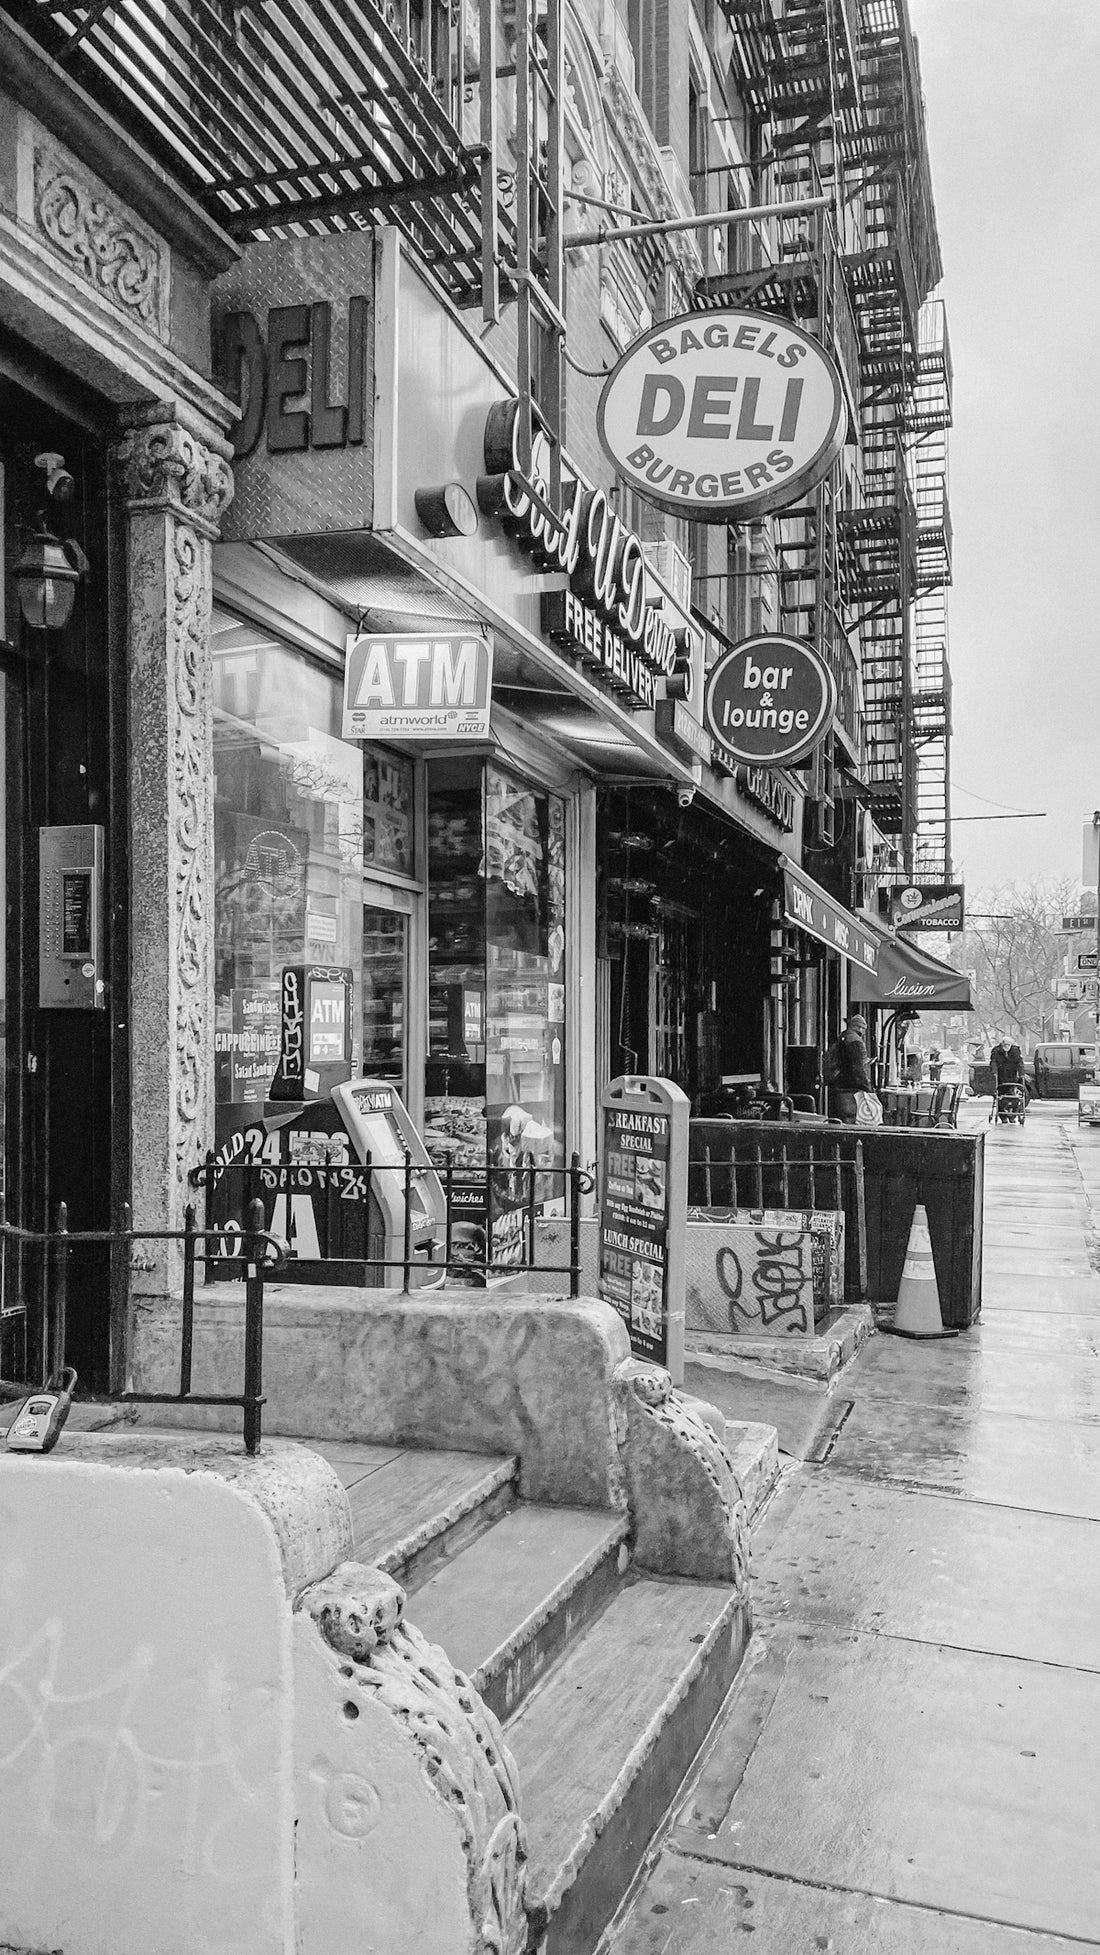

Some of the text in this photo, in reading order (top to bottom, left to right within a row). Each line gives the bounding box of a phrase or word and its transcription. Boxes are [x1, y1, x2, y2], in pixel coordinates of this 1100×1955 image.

[648, 324, 807, 368] BAGELS
[216, 295, 367, 457] DELI
[636, 374, 804, 442] DELI
[626, 443, 795, 498] BURGERS
[588, 489, 621, 609] U
[565, 590, 659, 711] FREE DELIVERY
[354, 640, 480, 707] ATM
[743, 656, 794, 690] bar
[759, 692, 774, 707] &
[380, 715, 447, 725] atmworld
[457, 723, 485, 732] NYCE
[722, 700, 809, 734] lounge
[920, 918, 960, 926] TOBACCO
[1069, 919, 1075, 928] E
[1081, 958, 1097, 966] ONE
[884, 975, 935, 996] lucien
[312, 1000, 344, 1023] ATM
[375, 1093, 392, 1108] ATM
[245, 1129, 282, 1166] 24
[621, 1134, 653, 1151] SPECIAL
[608, 1151, 635, 1178] FREE
[603, 1228, 664, 1260] LUNCH SPECIAL
[603, 1249, 631, 1279] FREE
